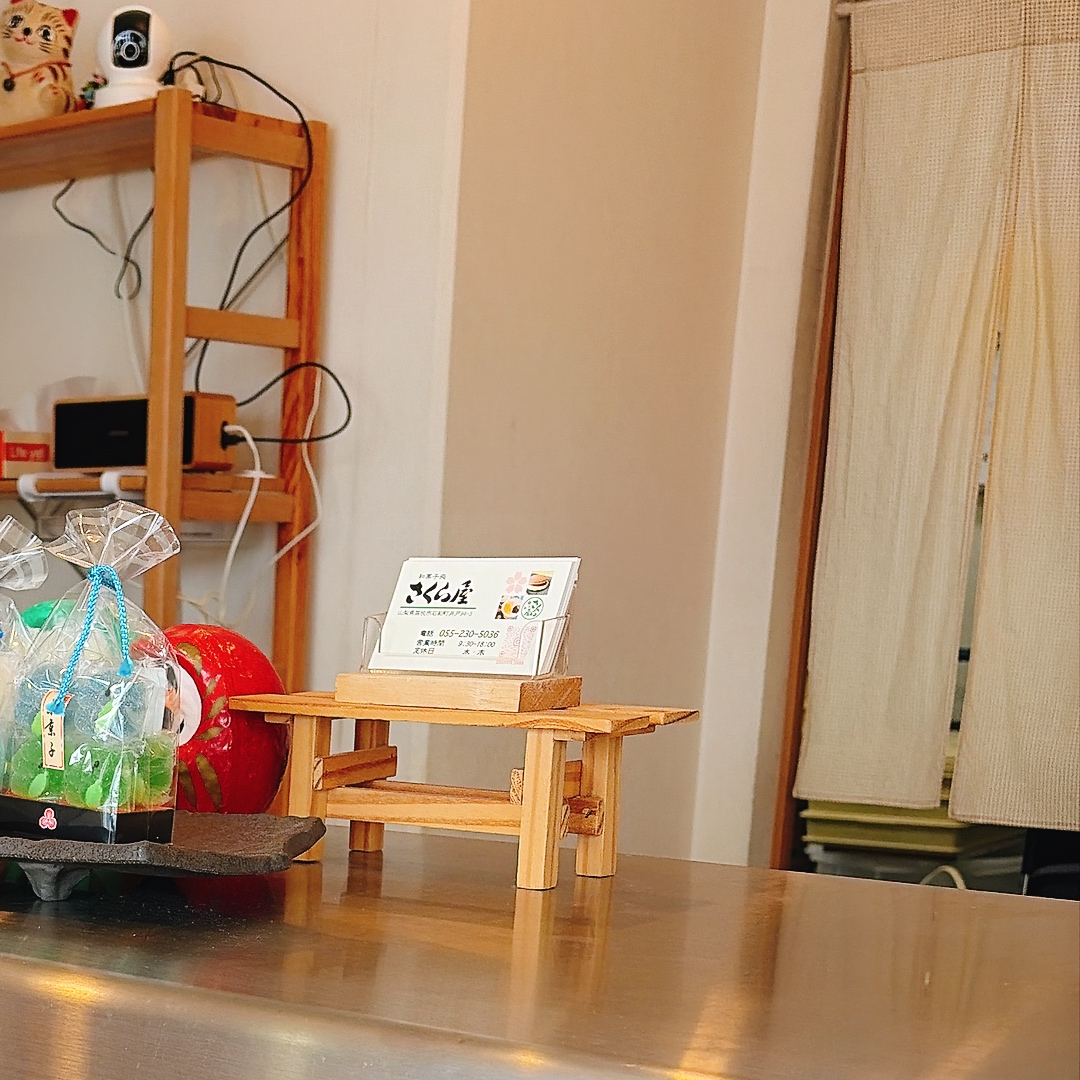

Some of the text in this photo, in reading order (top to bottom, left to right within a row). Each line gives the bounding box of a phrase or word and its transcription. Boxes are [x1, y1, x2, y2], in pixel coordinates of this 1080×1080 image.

[406, 580, 473, 604] さくら屋
[438, 629, 499, 639] 055-230-5036
[413, 647, 435, 655] 定休日
